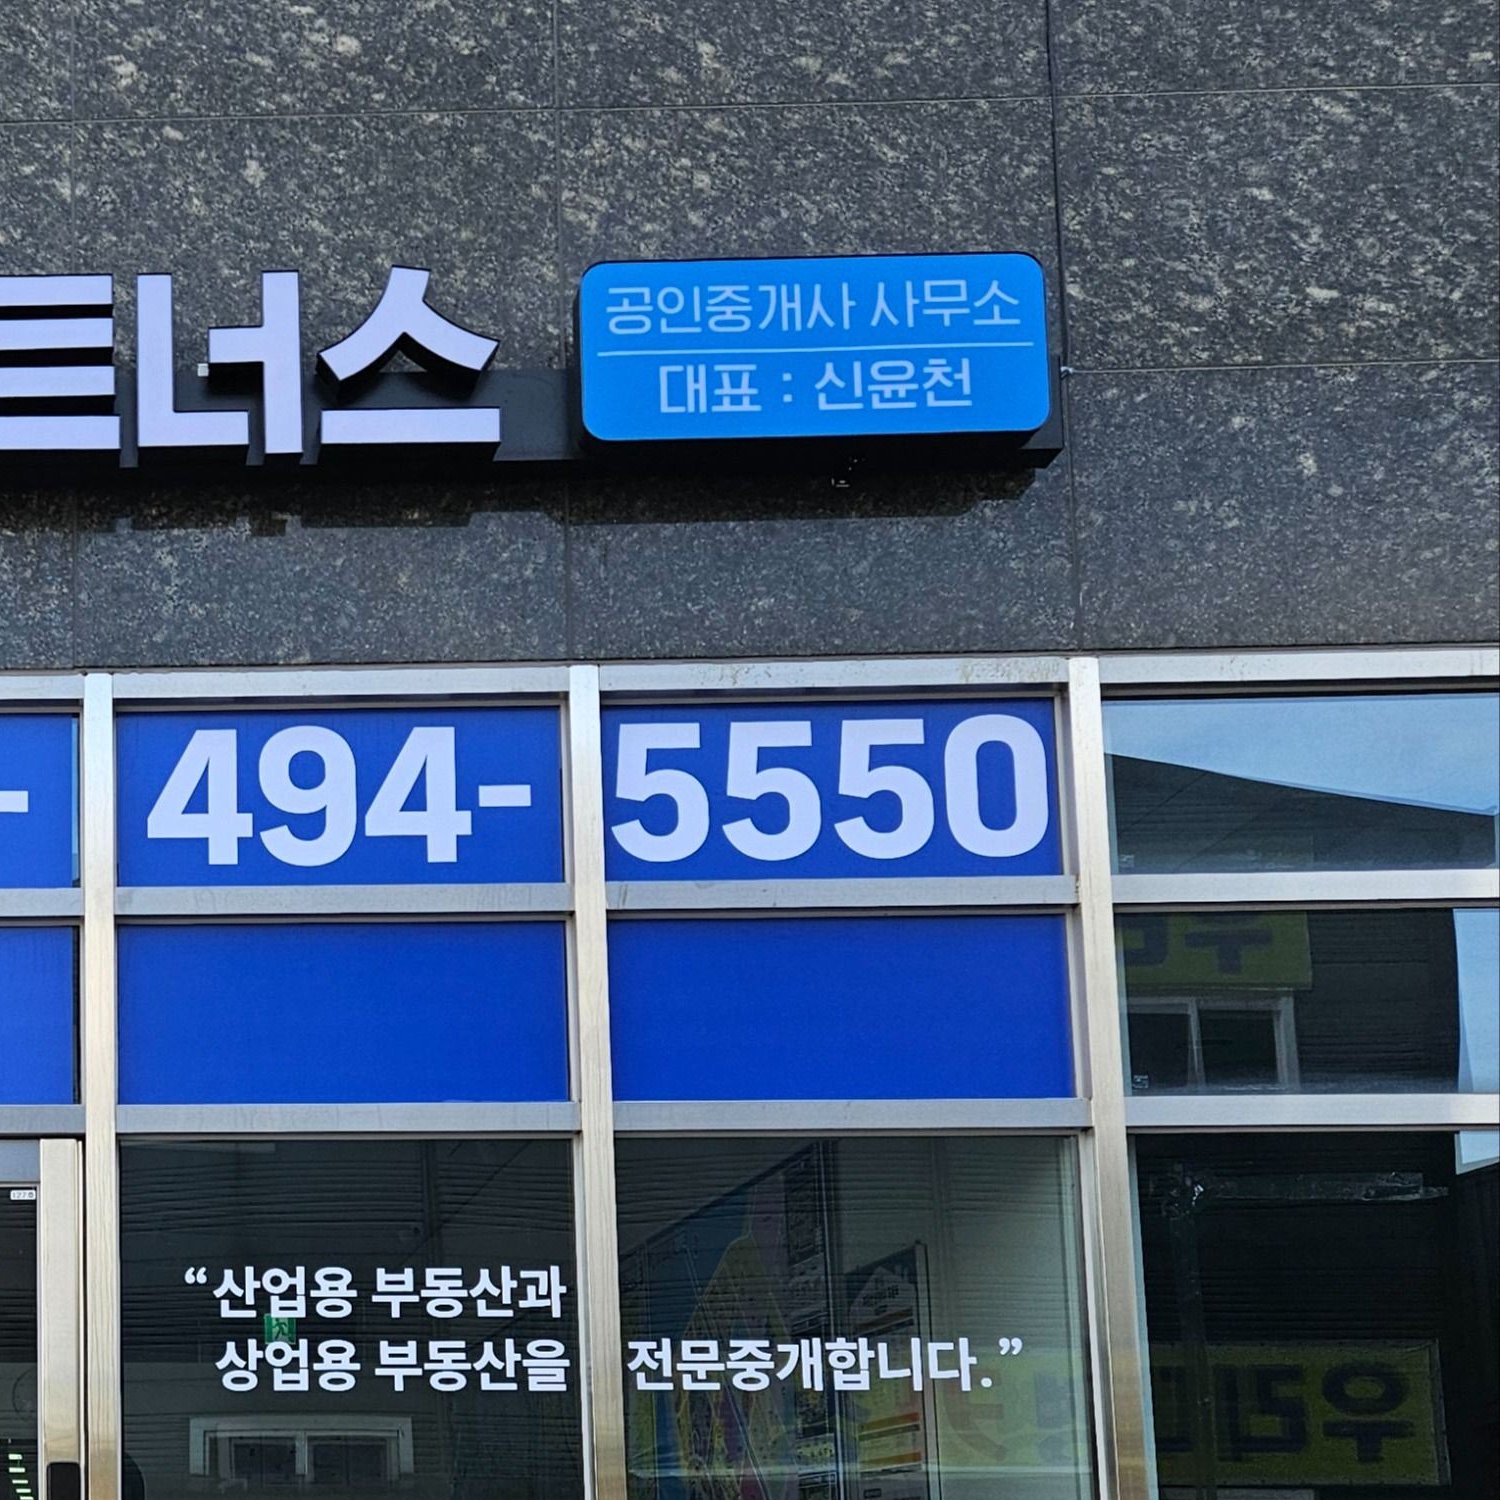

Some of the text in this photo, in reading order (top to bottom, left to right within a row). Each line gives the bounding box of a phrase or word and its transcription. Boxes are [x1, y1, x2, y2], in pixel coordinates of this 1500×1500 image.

[606, 280, 1021, 335] 공인중개사 사무소
[659, 364, 762, 413] 대표
[815, 358, 973, 411] 신윤천
[612, 714, 1049, 862] 5550
[372, 1266, 567, 1319] 부동산과
[215, 1340, 361, 1392] 상업용
[375, 1339, 570, 1392] 부동산을
